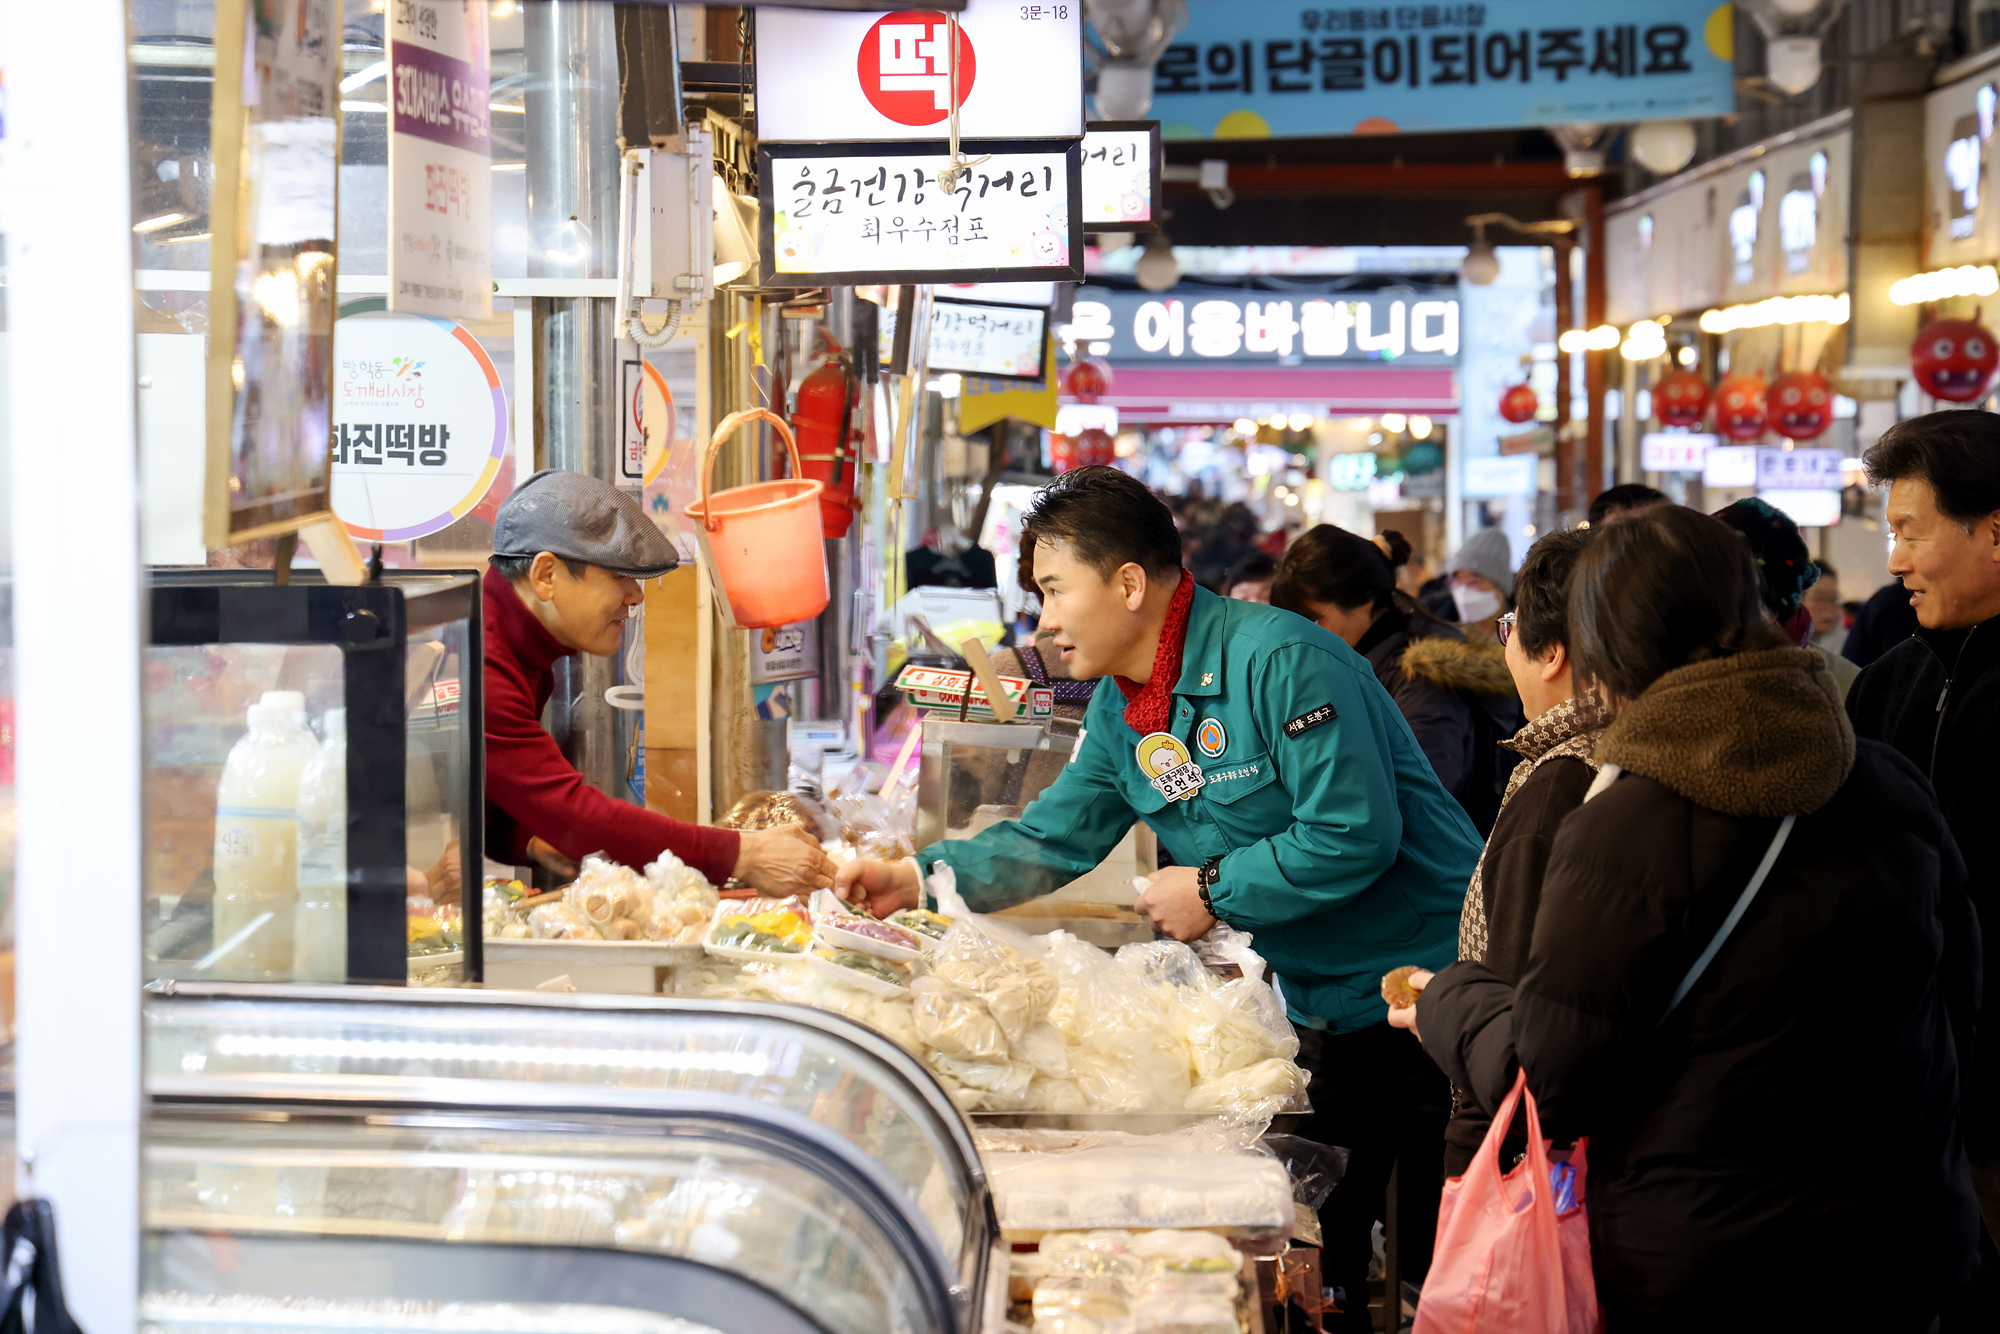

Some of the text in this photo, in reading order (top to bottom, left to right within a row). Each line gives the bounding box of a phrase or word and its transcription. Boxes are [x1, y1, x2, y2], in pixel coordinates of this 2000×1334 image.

[1019, 5, 1069, 21] 3문-18
[878, 23, 949, 110] 떡
[860, 214, 989, 246] 최우수점포
[342, 359, 394, 380] 방학동
[343, 380, 425, 409] 도깨비시장
[1288, 707, 1332, 733] 서울 도봉구
[1159, 764, 1190, 785] 도봉구청장
